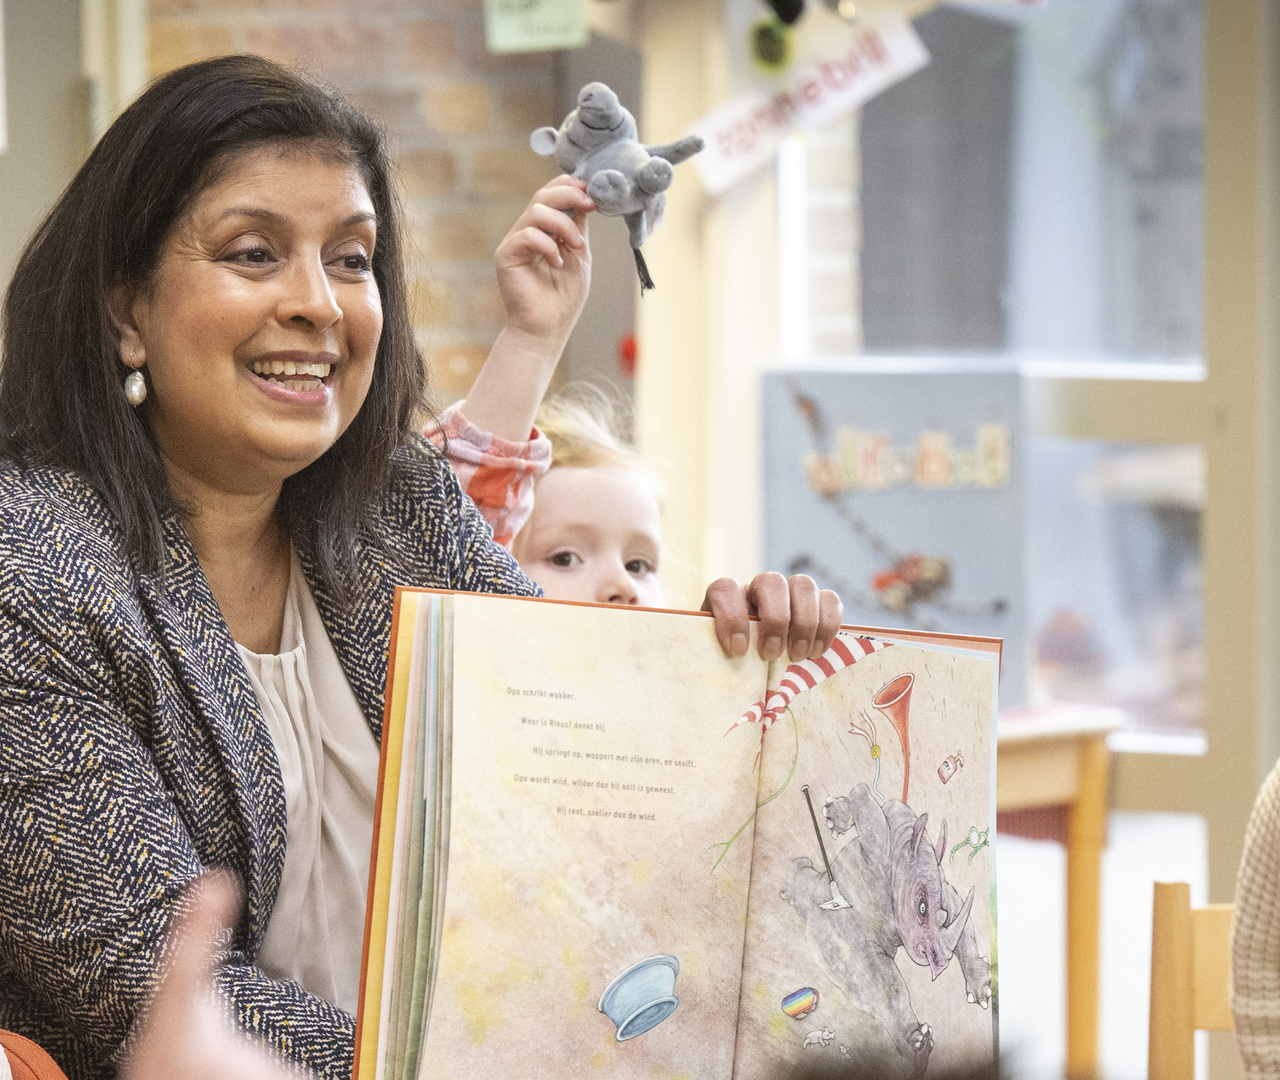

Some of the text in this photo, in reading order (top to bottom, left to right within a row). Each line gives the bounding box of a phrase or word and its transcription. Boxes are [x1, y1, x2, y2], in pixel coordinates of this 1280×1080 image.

[507, 687, 576, 700] Opa schrikt wakker.
[521, 717, 539, 725] Waar
[549, 719, 572, 728] Rinus?
[574, 722, 593, 730] denkt
[595, 723, 607, 732] hij.
[533, 747, 543, 756] Hij
[545, 748, 570, 759] springt
[572, 751, 583, 759] op,
[585, 753, 614, 761] wappert
[630, 755, 643, 764] zijn
[645, 757, 662, 766] oren,
[674, 760, 696, 768] snuift.
[514, 774, 528, 783] Opa
[530, 776, 550, 784] wordt
[552, 777, 569, 786] wild,
[572, 779, 594, 788] wilder
[596, 780, 608, 788] dan
[610, 782, 620, 791] hij
[622, 783, 636, 791] ooit
[645, 785, 676, 794] geweest.
[557, 806, 658, 821] Hij rent, sneller dan de wind.
